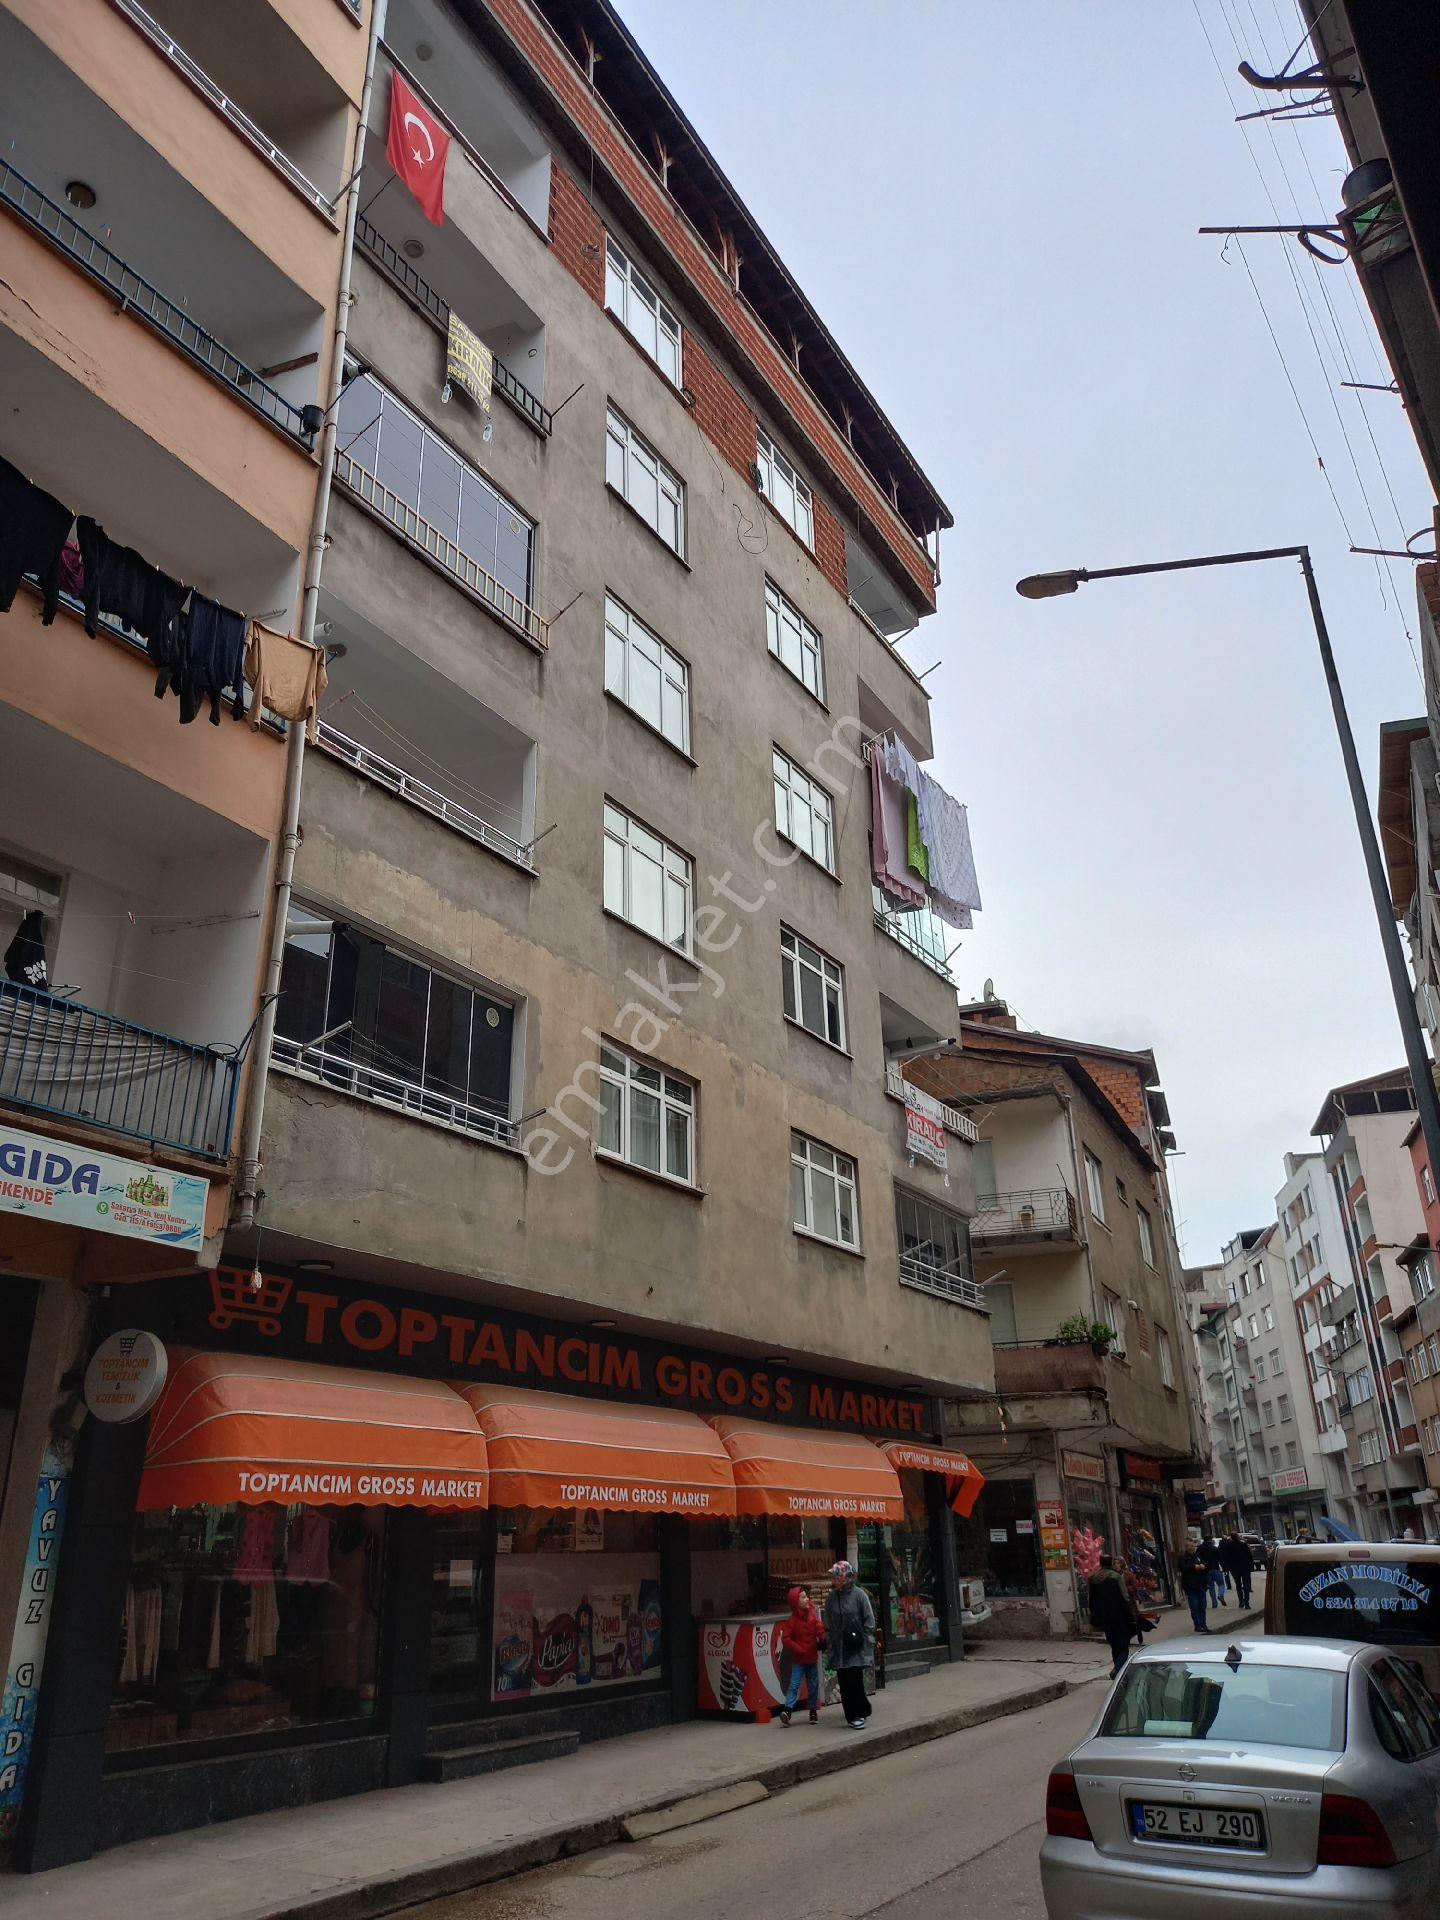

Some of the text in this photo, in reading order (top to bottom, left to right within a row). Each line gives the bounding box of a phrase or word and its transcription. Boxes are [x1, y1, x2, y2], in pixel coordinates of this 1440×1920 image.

[0, 1143, 100, 1196] GIDA
[296, 1289, 924, 1432] TOPTANCIM GROSS MARKET
[238, 1472, 482, 1499] TOPTANCIM GROSS MARKET
[560, 1484, 710, 1508] TOPTANCIM GROSS MARKET
[788, 1496, 887, 1514] TOPTANCIM GROSS MARKET
[1299, 1564, 1430, 1605] CEZAN MOBİLYA
[1313, 1596, 1324, 1609] 0
[0, 1478, 62, 1792] YAVUZ GIDA
[541, 1631, 574, 1668] Papia
[706, 1649, 731, 1658] ALGIDA
[1144, 1808, 1169, 1831] 52
[1179, 1811, 1204, 1834] EJ
[1216, 1814, 1255, 1839] 290
